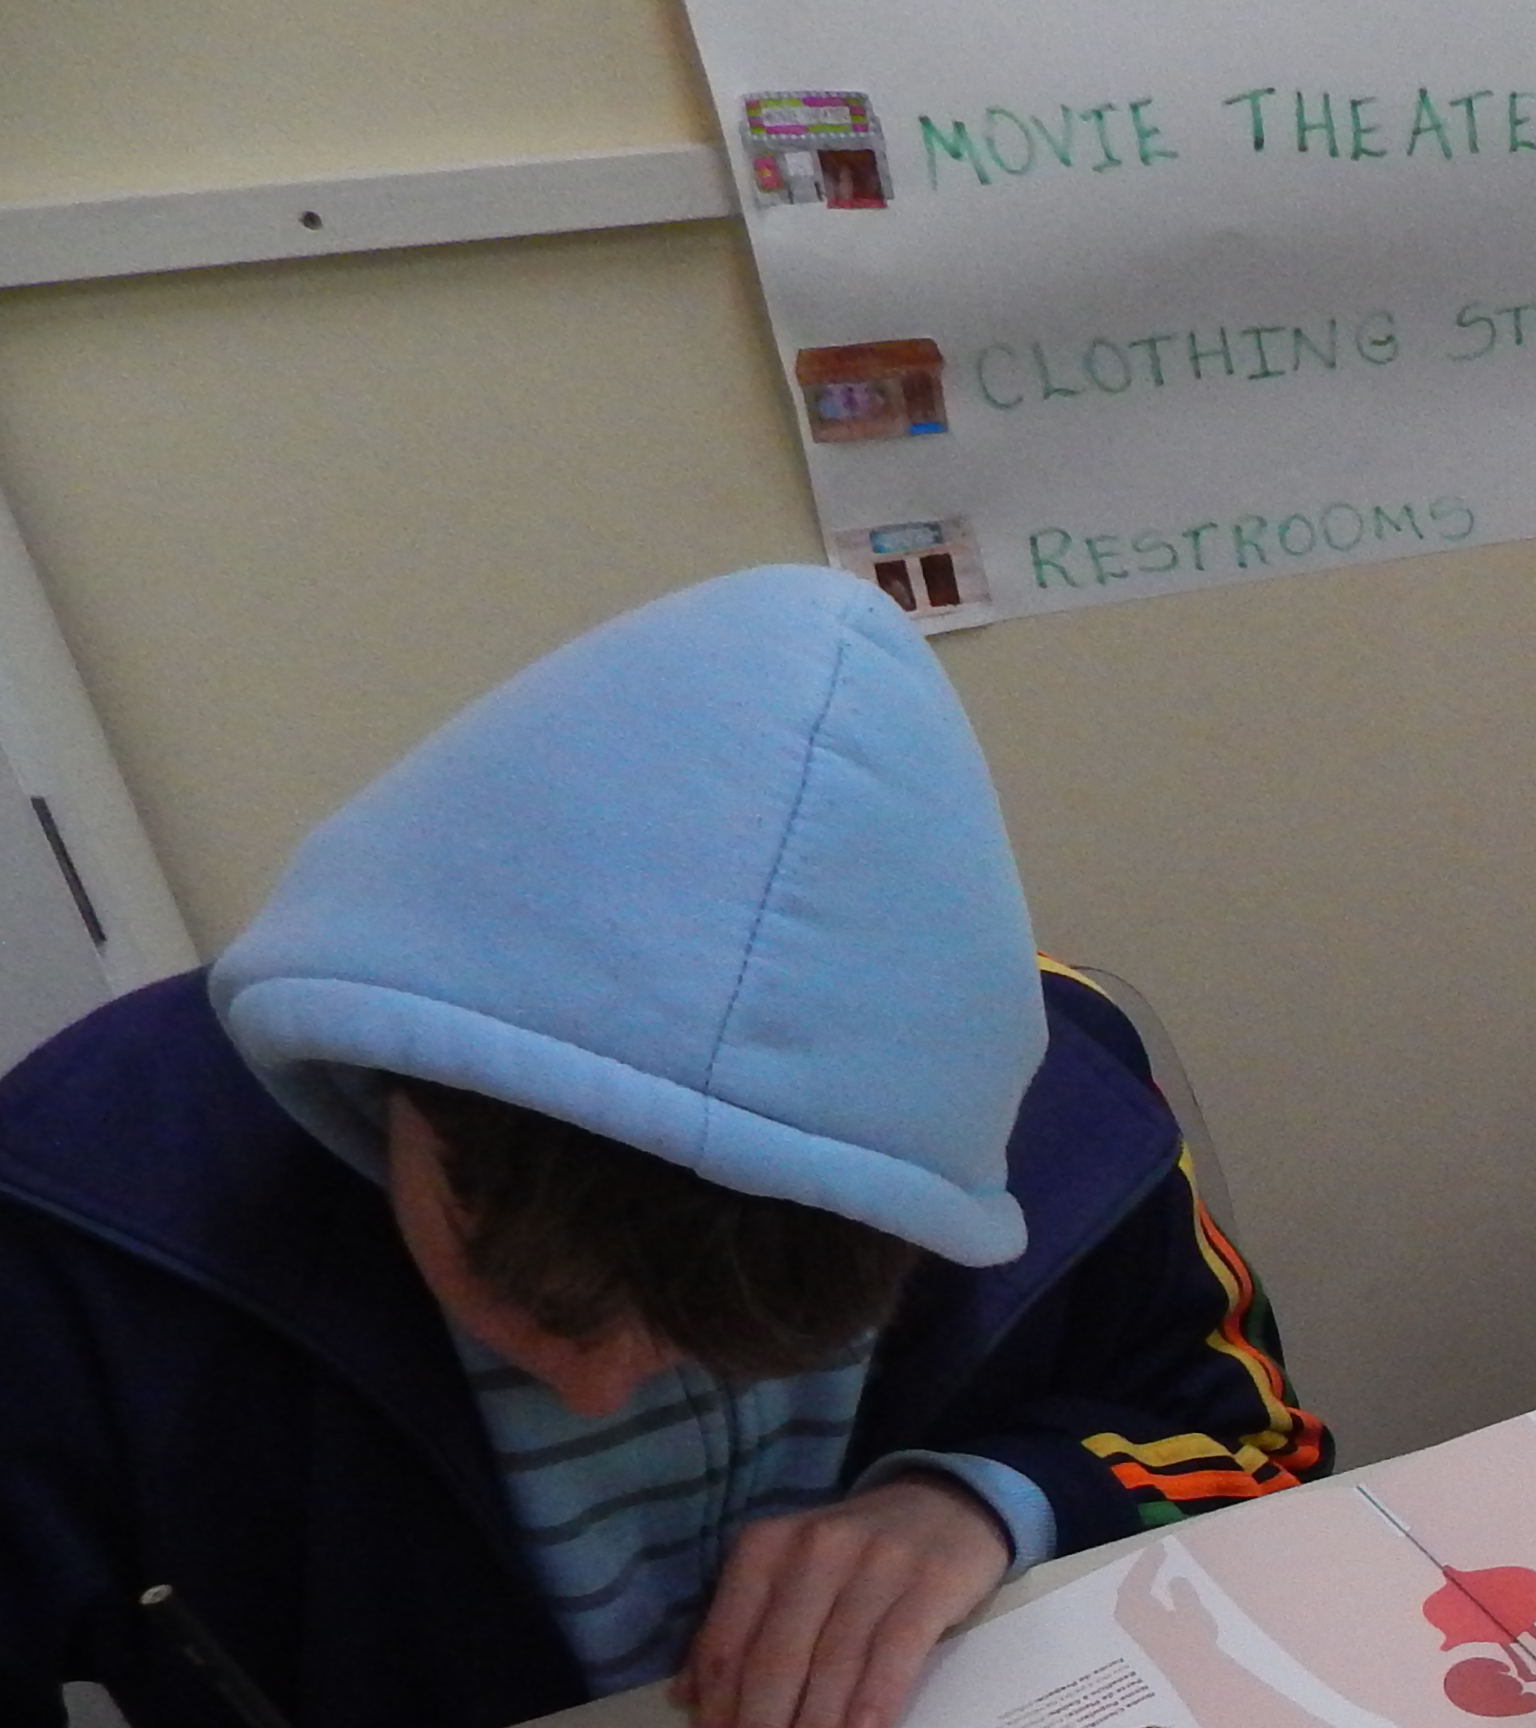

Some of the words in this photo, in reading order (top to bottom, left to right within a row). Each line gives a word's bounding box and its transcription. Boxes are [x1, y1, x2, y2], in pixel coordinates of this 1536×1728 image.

[919, 96, 1177, 191] MOVIE
[977, 311, 1403, 409] CLOTHING
[1028, 497, 1478, 591] RESTROOMS
